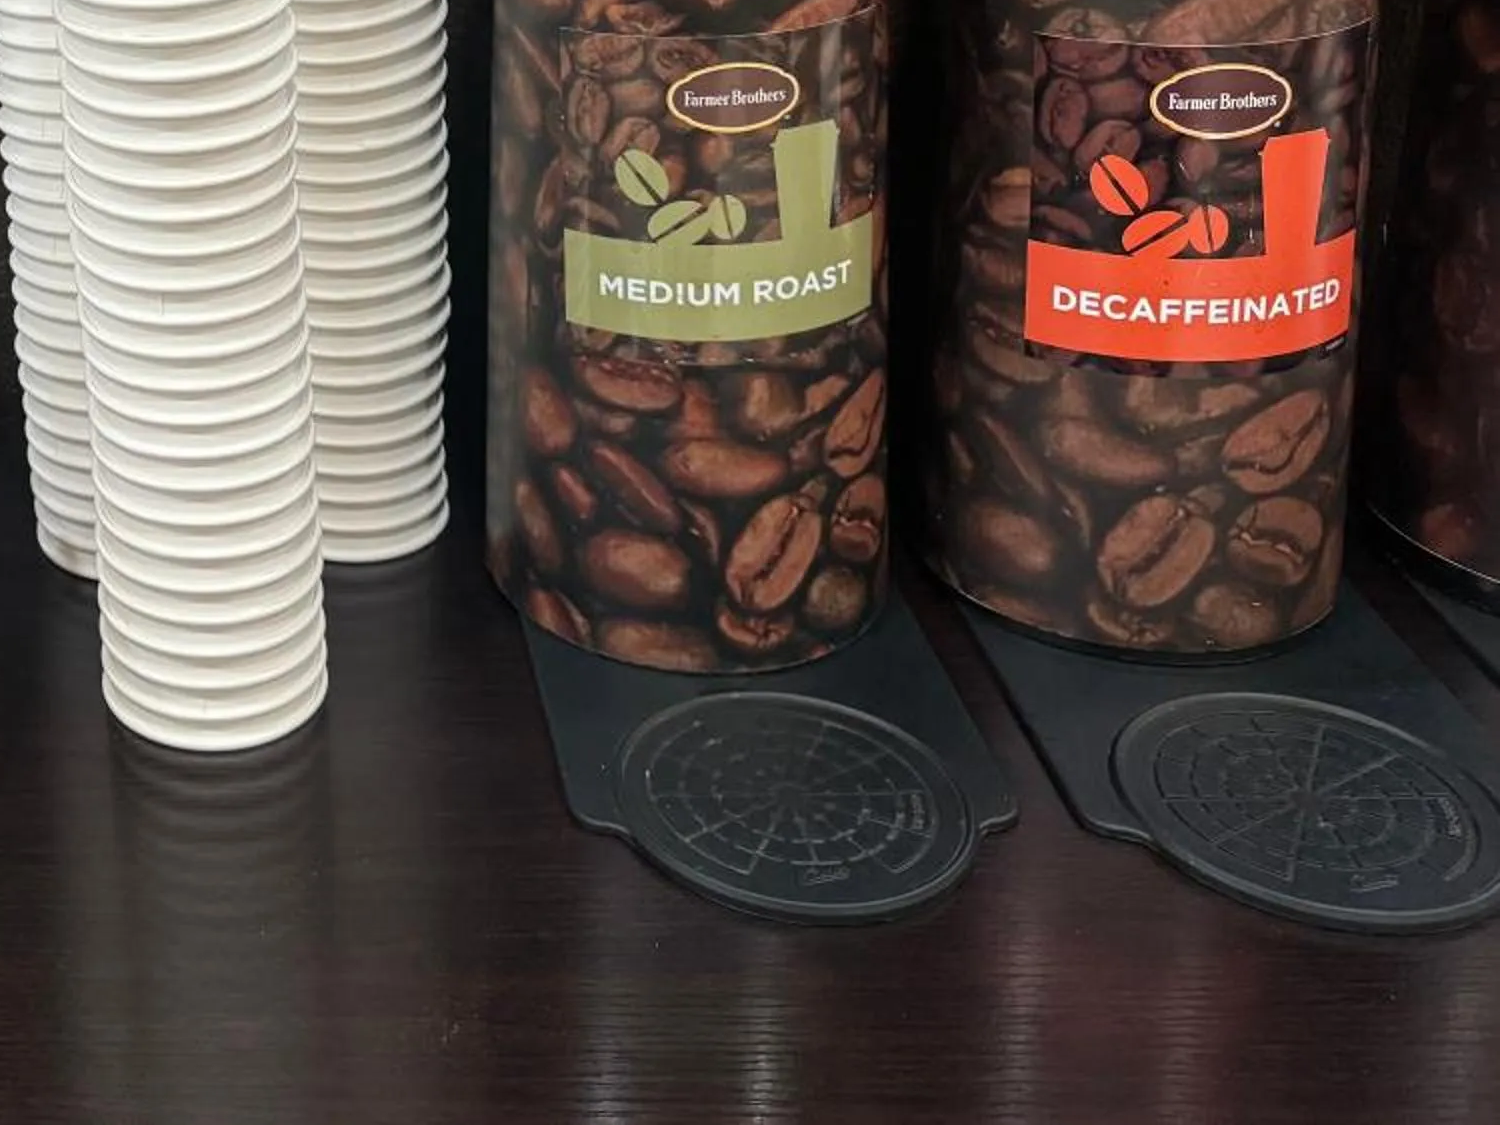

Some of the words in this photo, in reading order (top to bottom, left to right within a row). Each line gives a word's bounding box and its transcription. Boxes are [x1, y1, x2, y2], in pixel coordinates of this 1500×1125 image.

[684, 90, 729, 108] Farmer
[731, 87, 787, 106] Brothers
[1168, 92, 1218, 111] Farmer
[1219, 91, 1278, 111] Brothers
[599, 272, 741, 307] MEDIUM
[753, 259, 853, 305] ROAST
[1052, 278, 1341, 325] DECAFFEINATED
